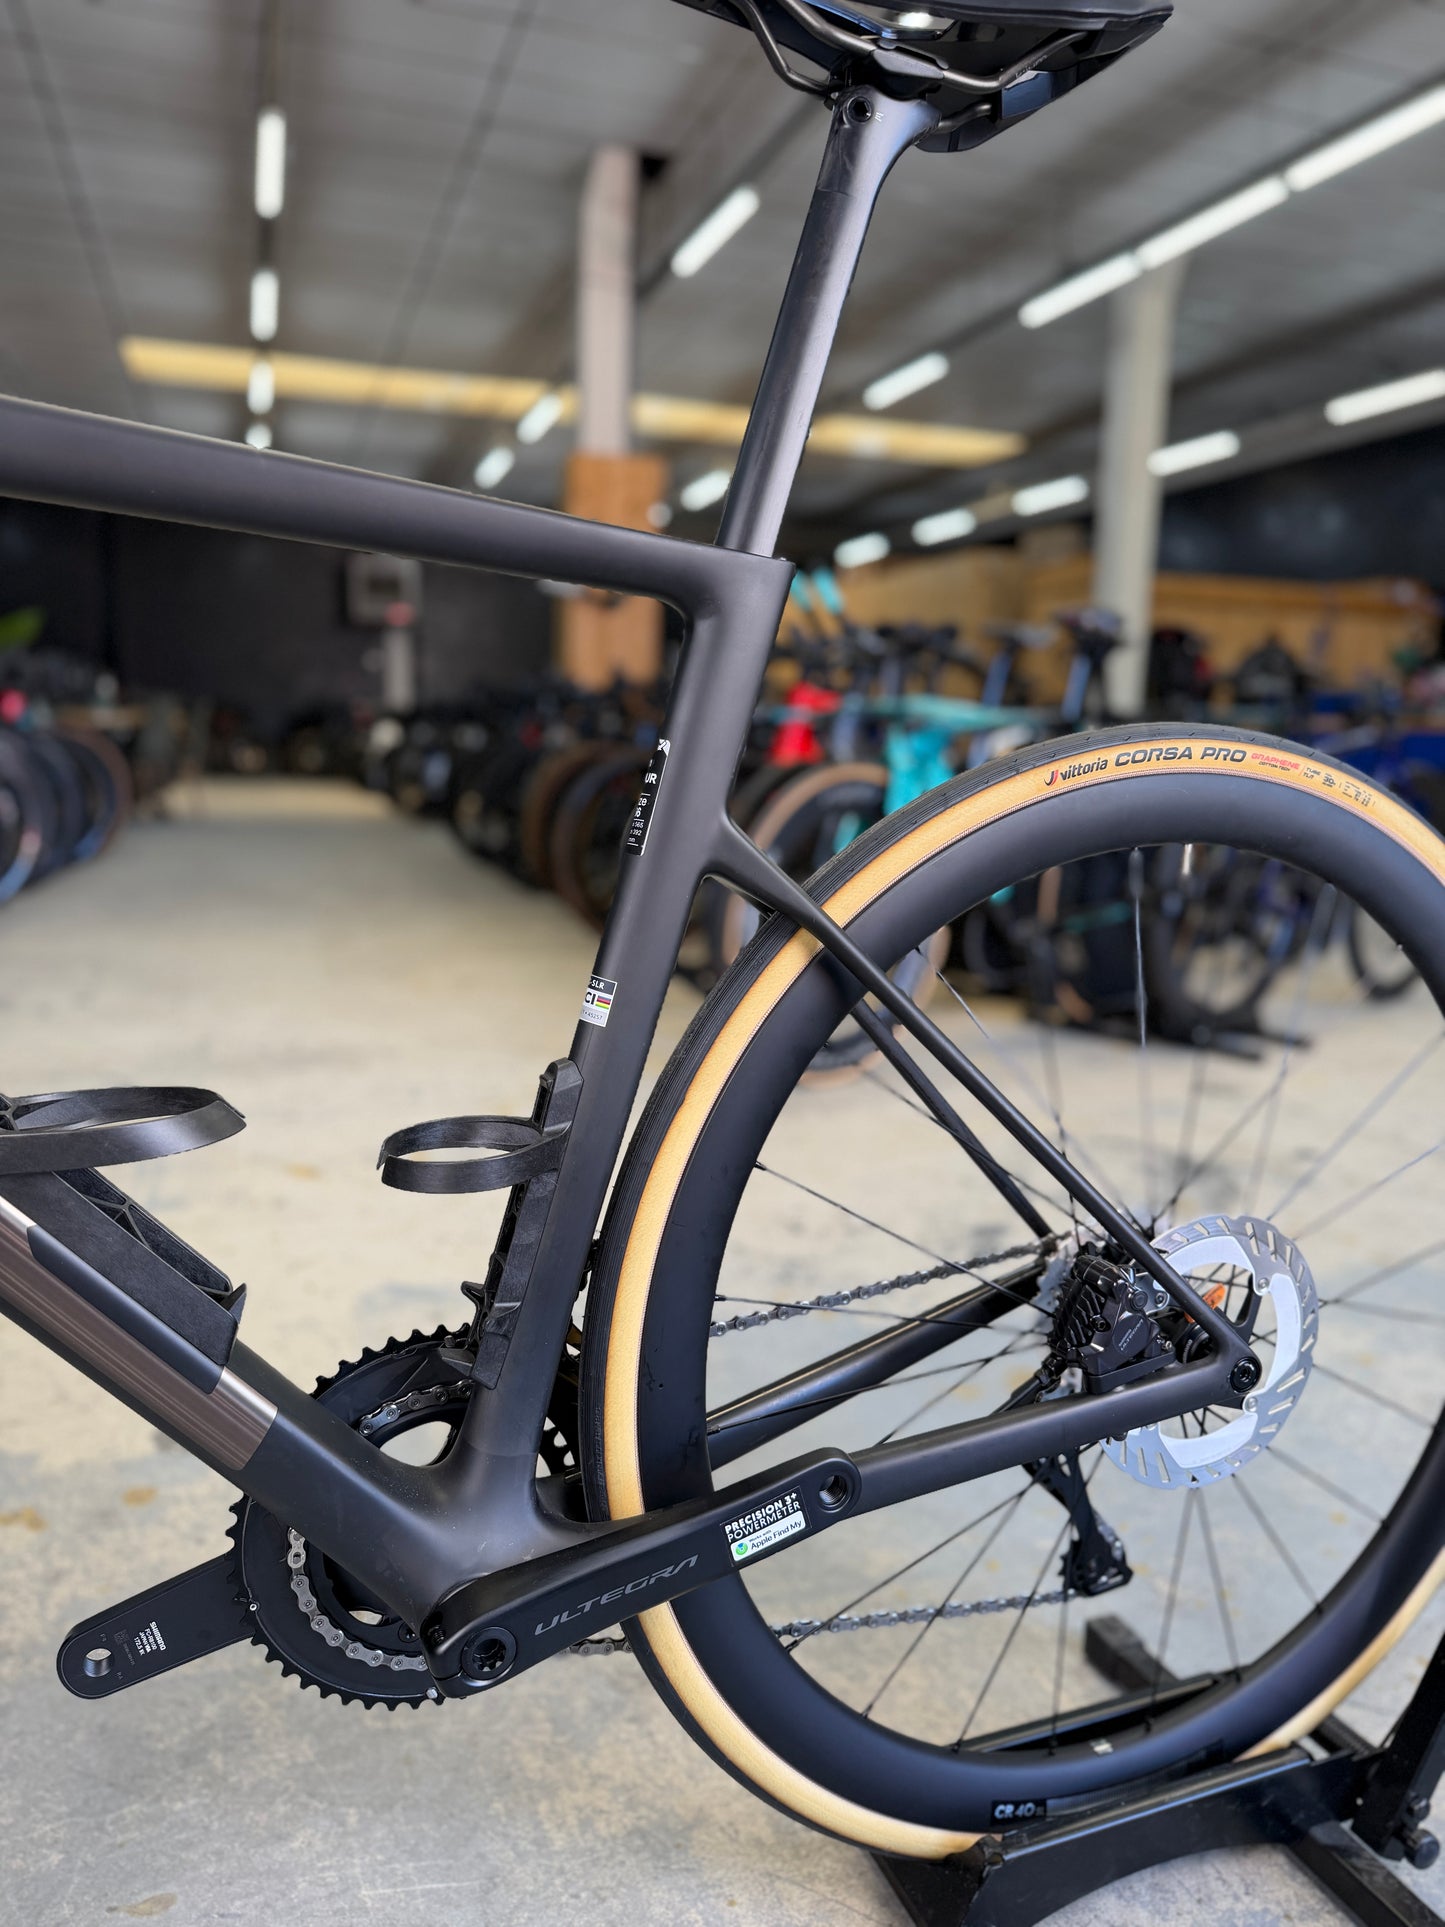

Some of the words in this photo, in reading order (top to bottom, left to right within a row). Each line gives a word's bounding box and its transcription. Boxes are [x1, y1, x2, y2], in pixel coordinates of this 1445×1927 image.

[1060, 757, 1108, 781] vittoria
[1114, 747, 1193, 767] CORSA
[1200, 746, 1247, 763] PRO
[1251, 752, 1300, 770] GRAPHENE
[645, 773, 657, 784] UR
[586, 991, 596, 1005] CI
[725, 1500, 783, 1535] PRECISION
[784, 1492, 797, 1505] 3+
[727, 1501, 801, 1543] POWERMETER
[751, 1536, 773, 1550] Apple
[773, 1527, 790, 1539] Find
[790, 1520, 802, 1533] My
[534, 1554, 699, 1636] ULTEGRA
[150, 1621, 166, 1651] SHIMANO
[994, 1803, 1014, 1819] CR
[1014, 1802, 1036, 1818] 40
